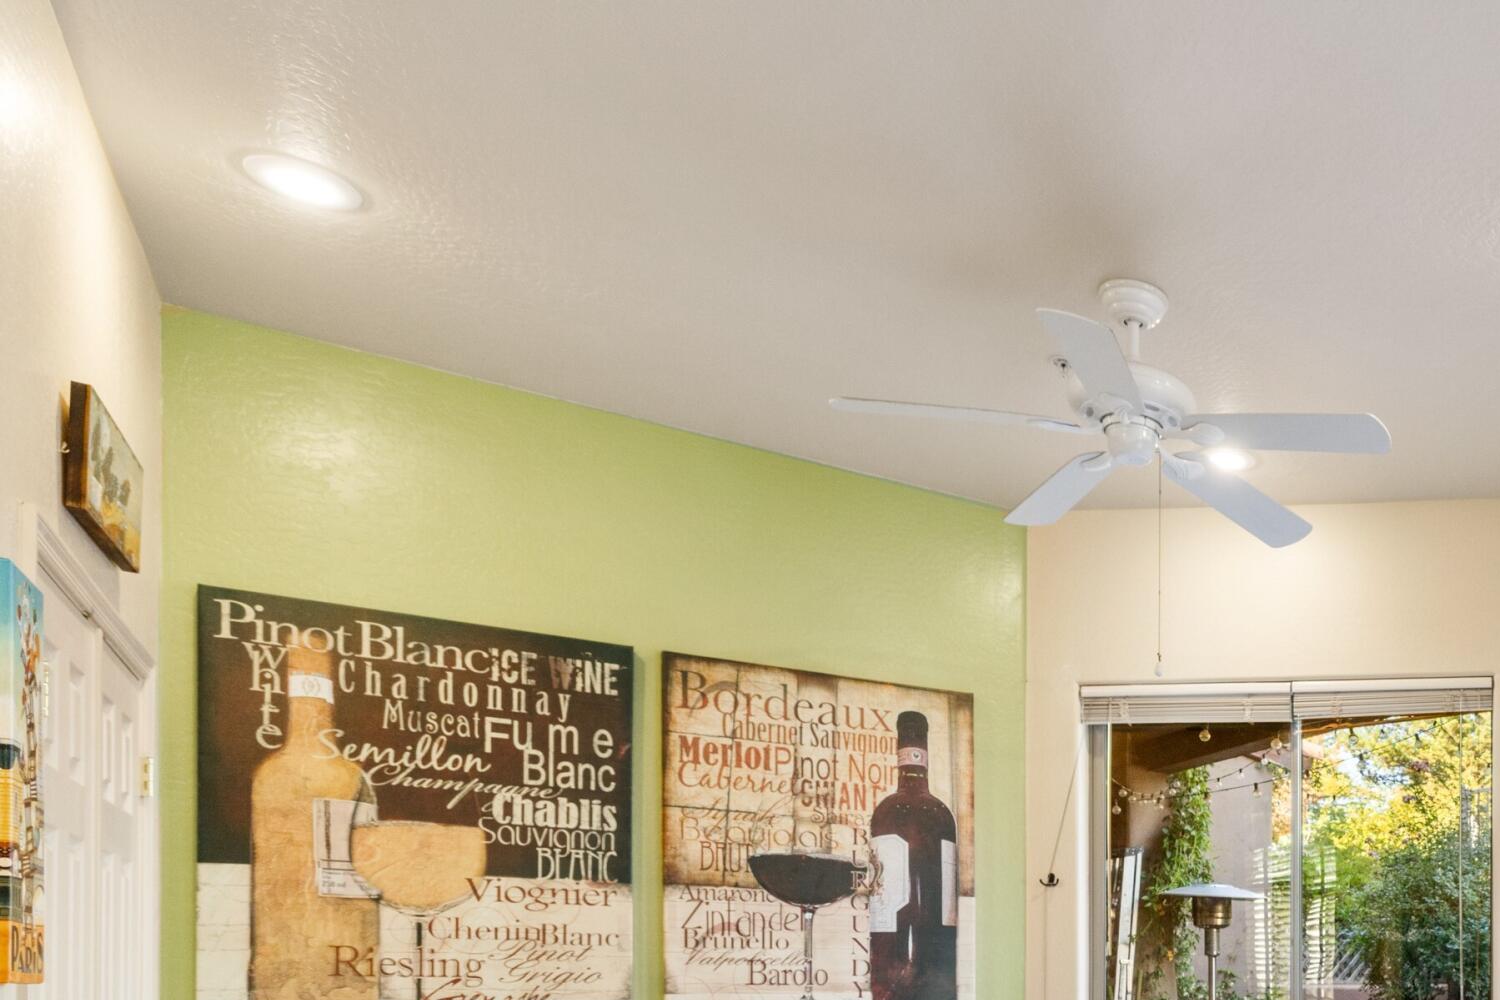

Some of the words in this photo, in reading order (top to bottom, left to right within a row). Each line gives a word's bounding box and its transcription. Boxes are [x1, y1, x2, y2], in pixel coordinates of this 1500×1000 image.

[213, 598, 354, 657] Pinot
[354, 620, 491, 674] Blanc
[338, 658, 572, 723] Chardonnay
[676, 669, 894, 733] Bordeaux
[382, 699, 481, 739] Muscat
[484, 716, 614, 759] Fume
[722, 712, 803, 746] Cabernet
[810, 722, 899, 757] Sauvignon
[312, 728, 492, 773] Semillon
[523, 748, 616, 793] Blanc
[678, 735, 773, 771] Merlot
[774, 744, 839, 782] Pinot
[849, 753, 899, 786] Noir
[367, 760, 563, 813] Champagne
[492, 793, 618, 832] Chablis
[478, 816, 616, 859] Sauvignon
[465, 876, 618, 912] Viognier
[428, 916, 541, 943] Chenin
[540, 923, 620, 947] Blanc
[681, 897, 804, 937] Zinfandel
[684, 926, 790, 950] Brunello
[328, 945, 486, 988] Riesling
[488, 939, 593, 961] Pinot
[498, 959, 602, 991] Grigio
[746, 958, 829, 986] Barolo
